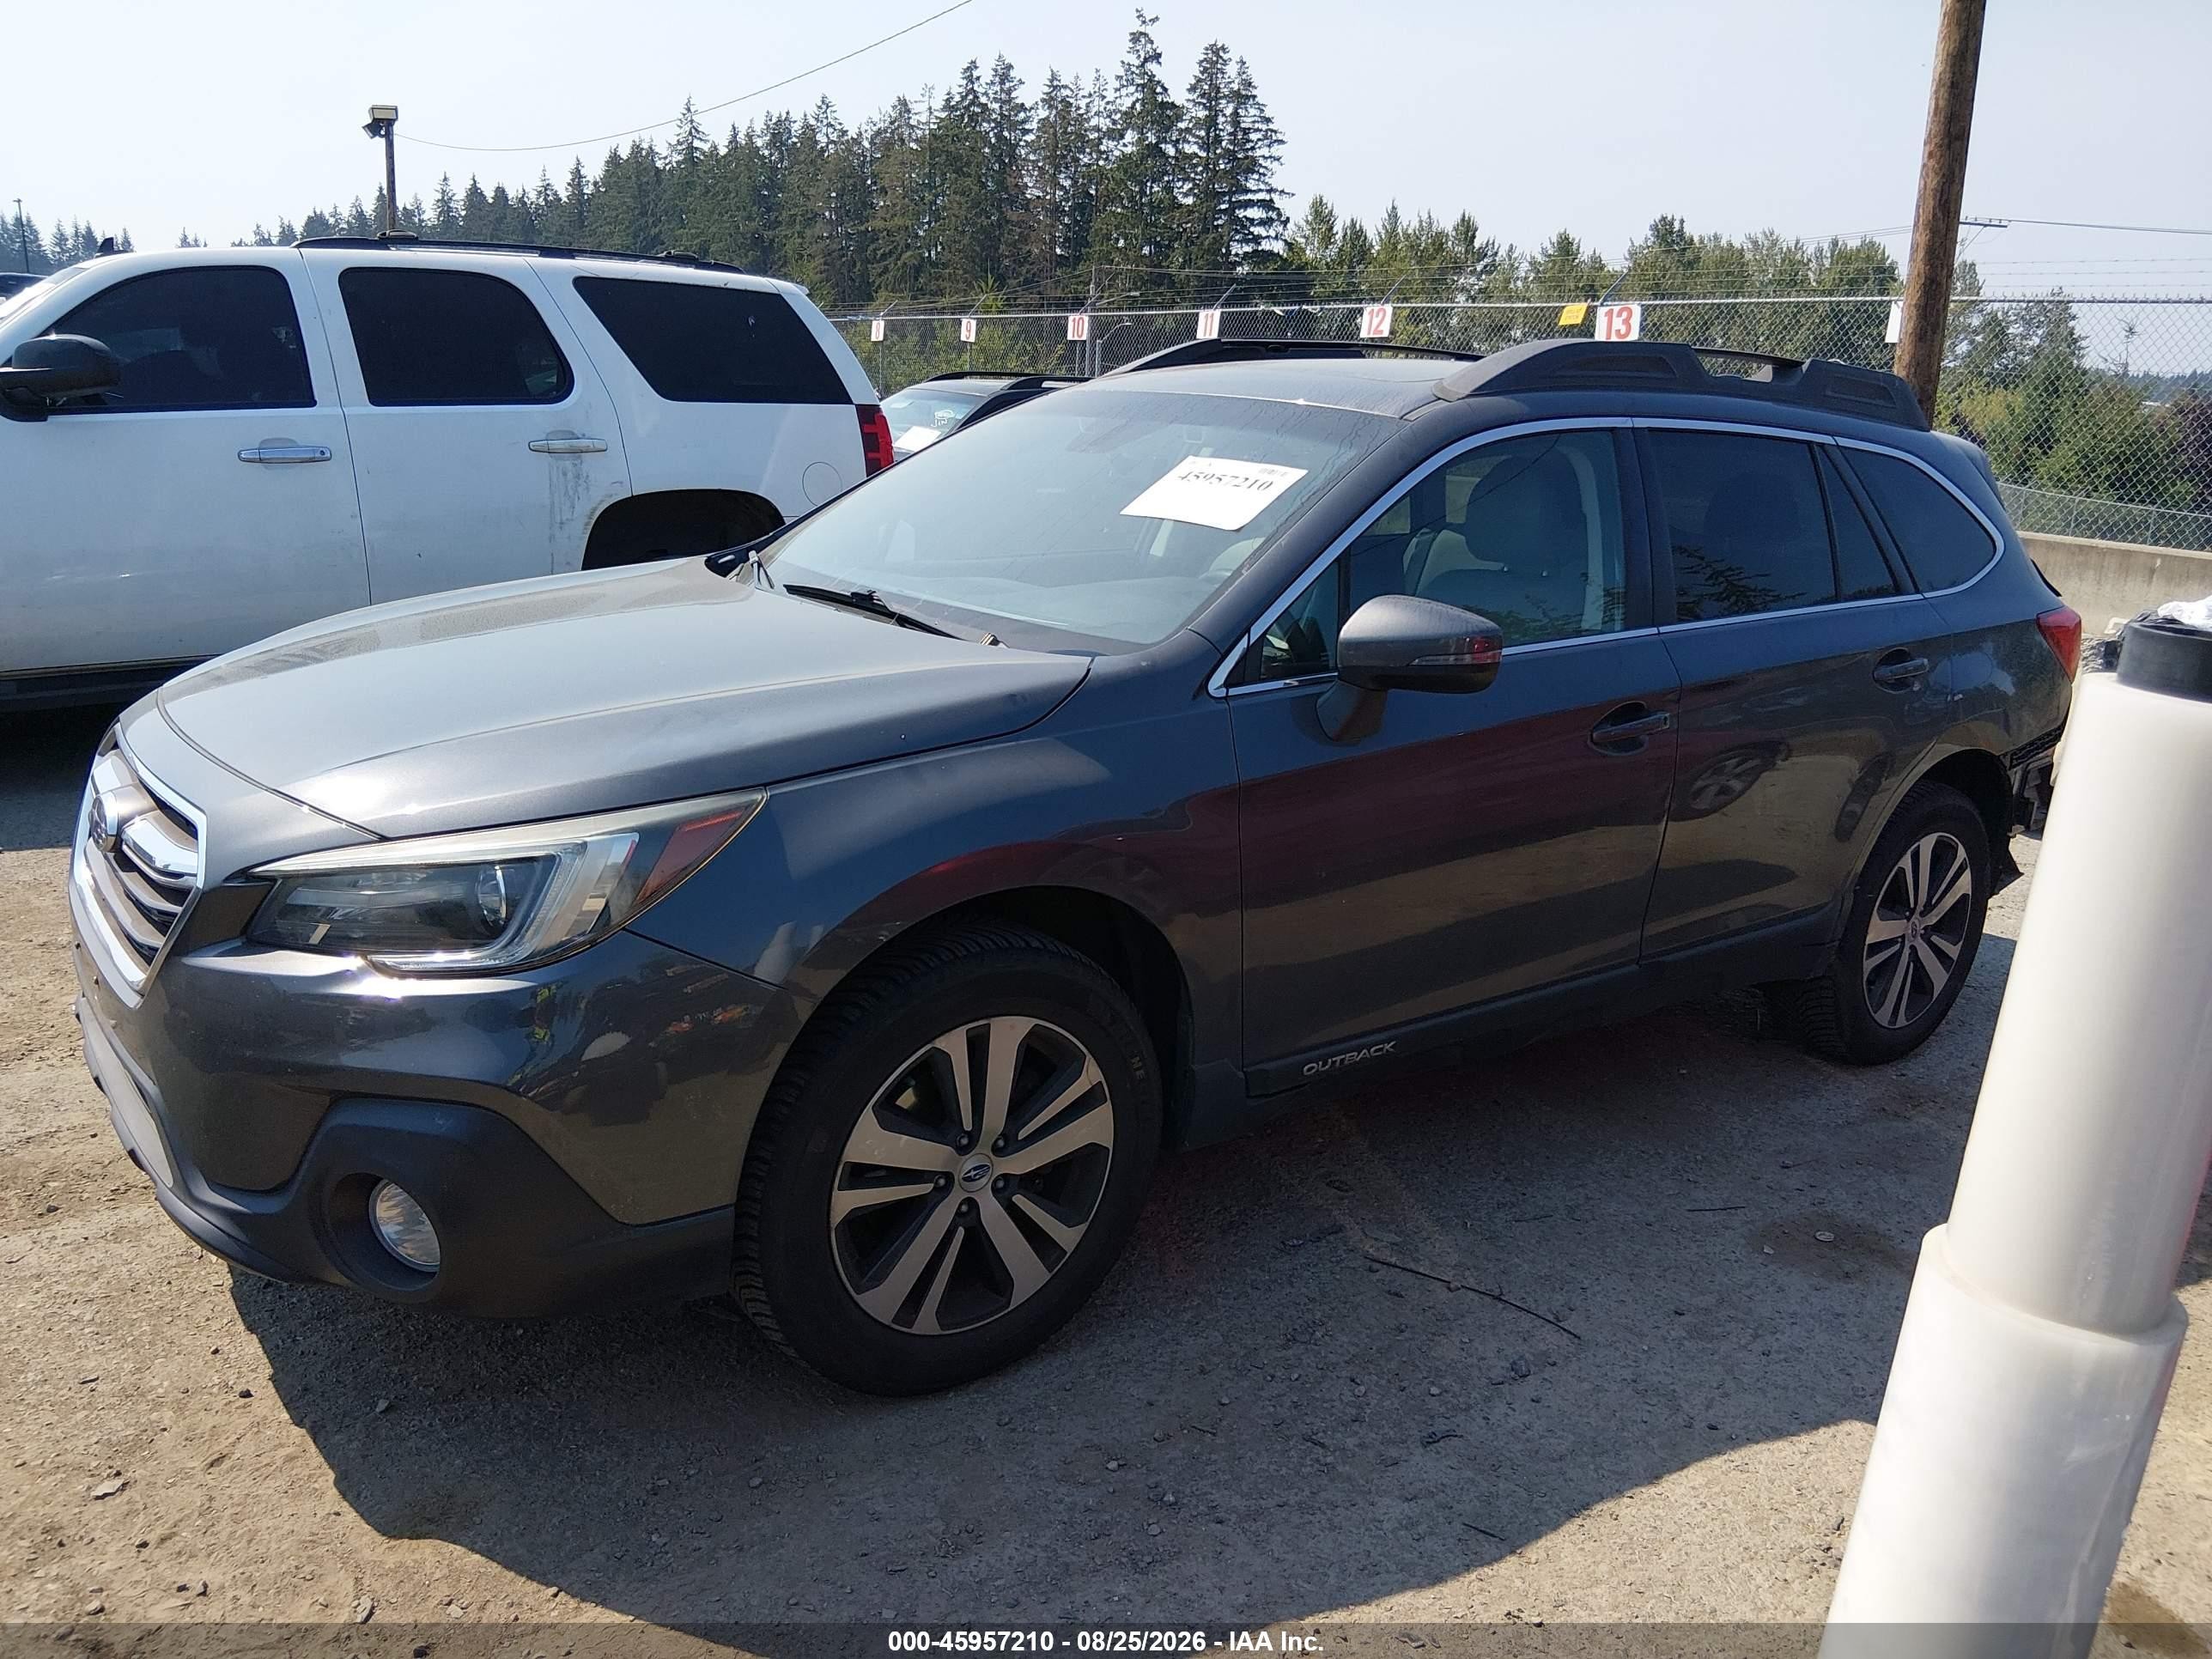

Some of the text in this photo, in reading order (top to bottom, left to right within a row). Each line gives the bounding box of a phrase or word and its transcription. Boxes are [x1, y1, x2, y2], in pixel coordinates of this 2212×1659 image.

[874, 322, 881, 340] 8
[964, 320, 972, 340] 9
[1071, 316, 1085, 339] 10
[1202, 312, 1215, 337] 11
[1366, 307, 1387, 336] 12
[1603, 306, 1634, 341] 13
[1177, 470, 1274, 491] 45957210
[1303, 1041, 1397, 1076] OUTBACK
